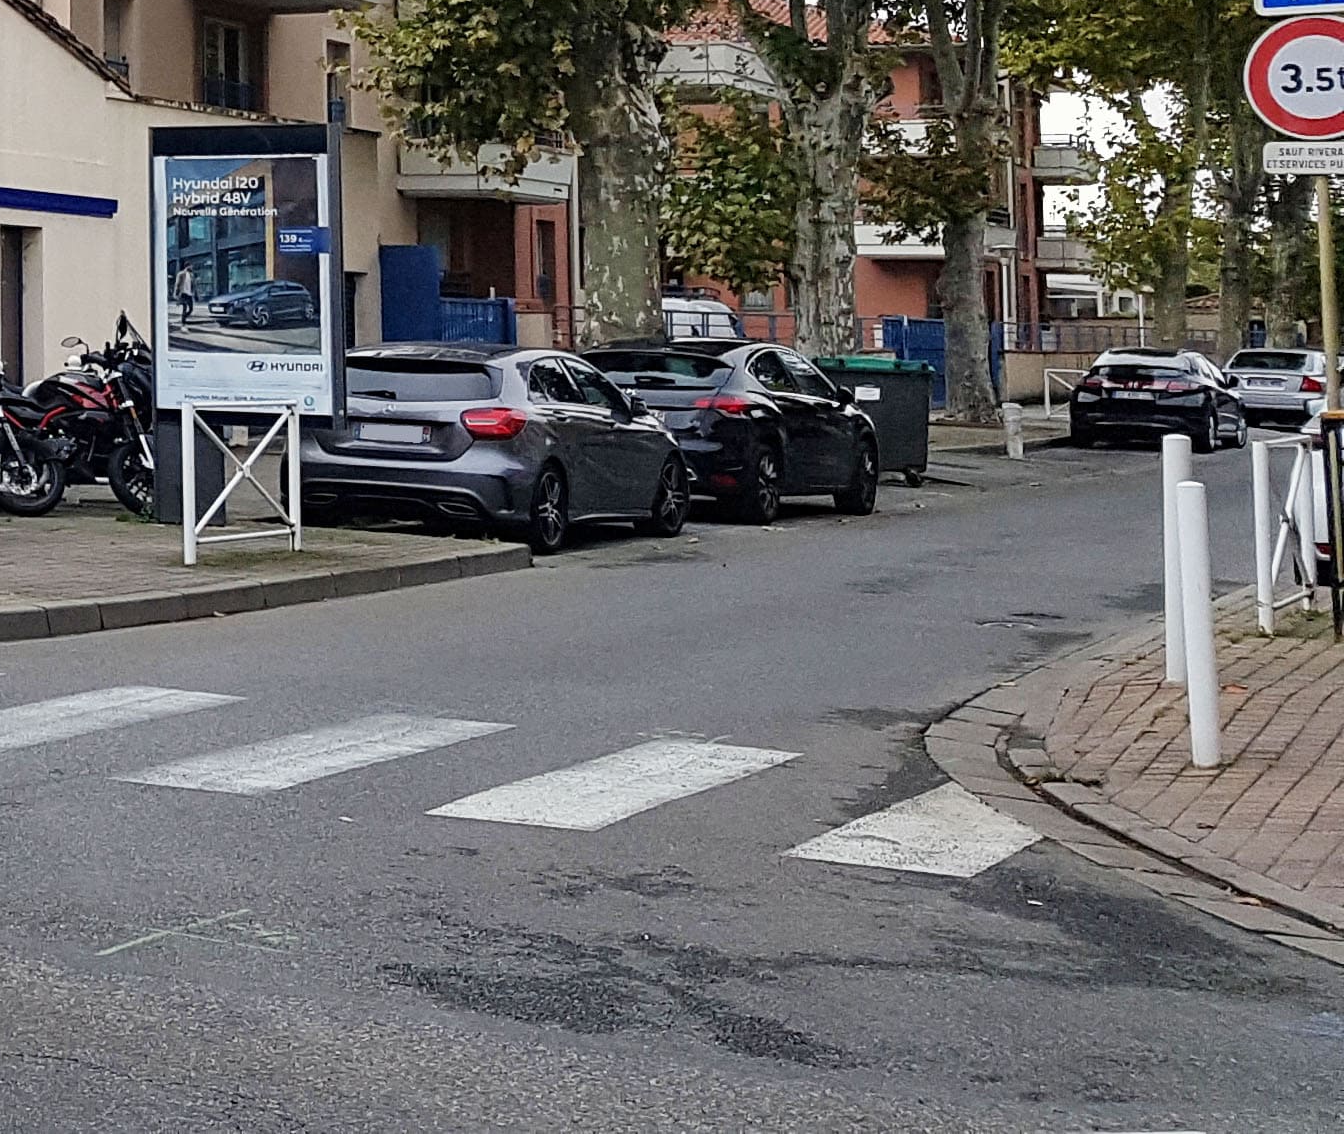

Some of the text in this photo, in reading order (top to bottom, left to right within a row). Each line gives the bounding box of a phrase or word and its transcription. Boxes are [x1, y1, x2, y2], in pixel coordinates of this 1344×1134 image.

[1279, 147, 1305, 157] SAUF
[1279, 159, 1326, 169] SERVICES
[172, 177, 259, 192] Hyundai i20
[172, 192, 252, 206] Hybrid 48V
[172, 206, 278, 216] Nouvelle Génération
[279, 234, 297, 244] 139
[270, 362, 324, 372] HYUNDAI
